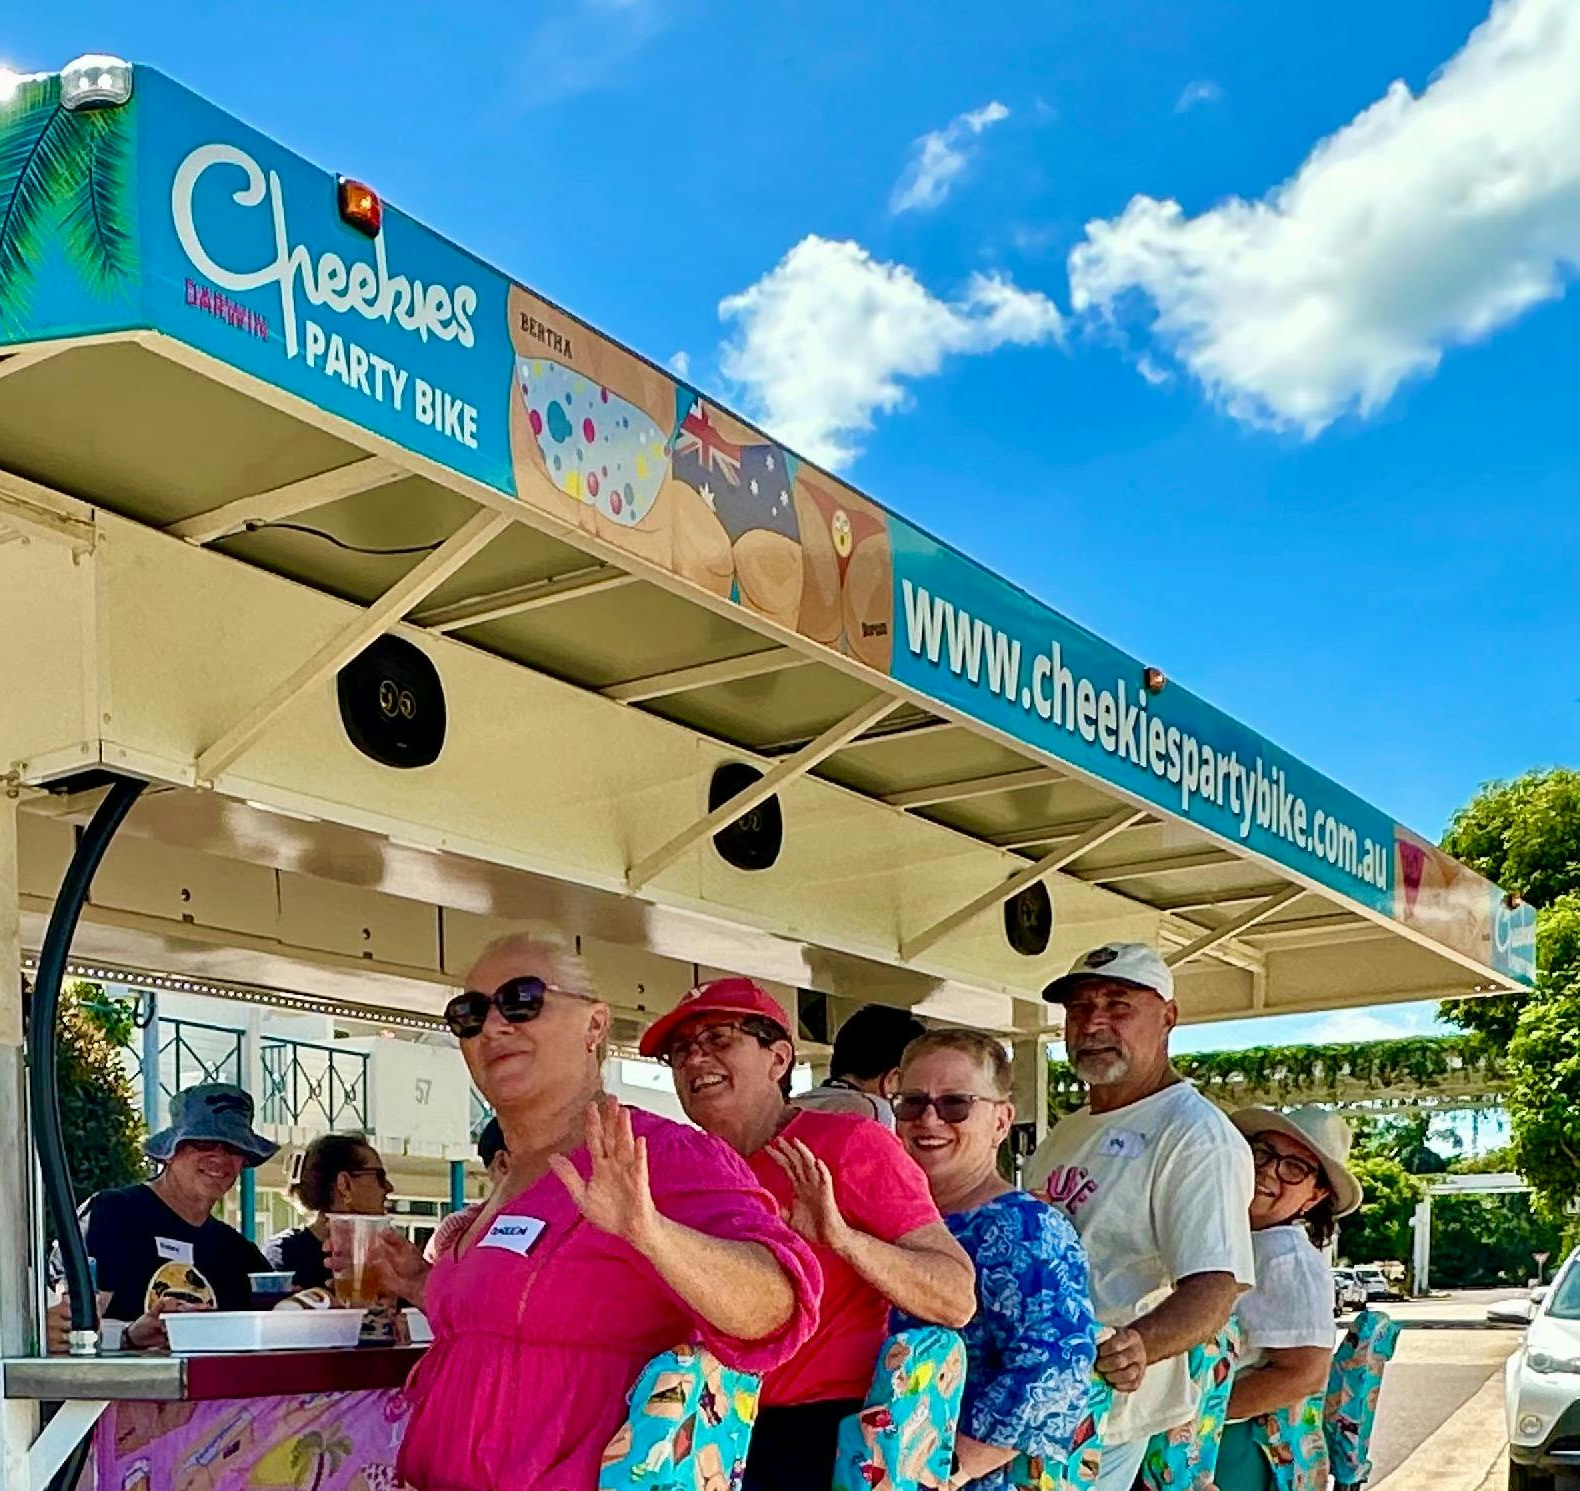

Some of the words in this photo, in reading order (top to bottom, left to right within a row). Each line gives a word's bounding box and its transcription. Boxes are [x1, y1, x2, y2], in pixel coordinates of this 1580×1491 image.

[171, 143, 478, 360] Cheekies
[184, 277, 270, 343] DARWIN
[520, 311, 573, 360] BERTHA
[306, 319, 409, 412] PARTY
[415, 378, 479, 450] BIKE
[901, 577, 1388, 892] www.cheekiespartybike.com.au
[415, 1078, 433, 1106] 57
